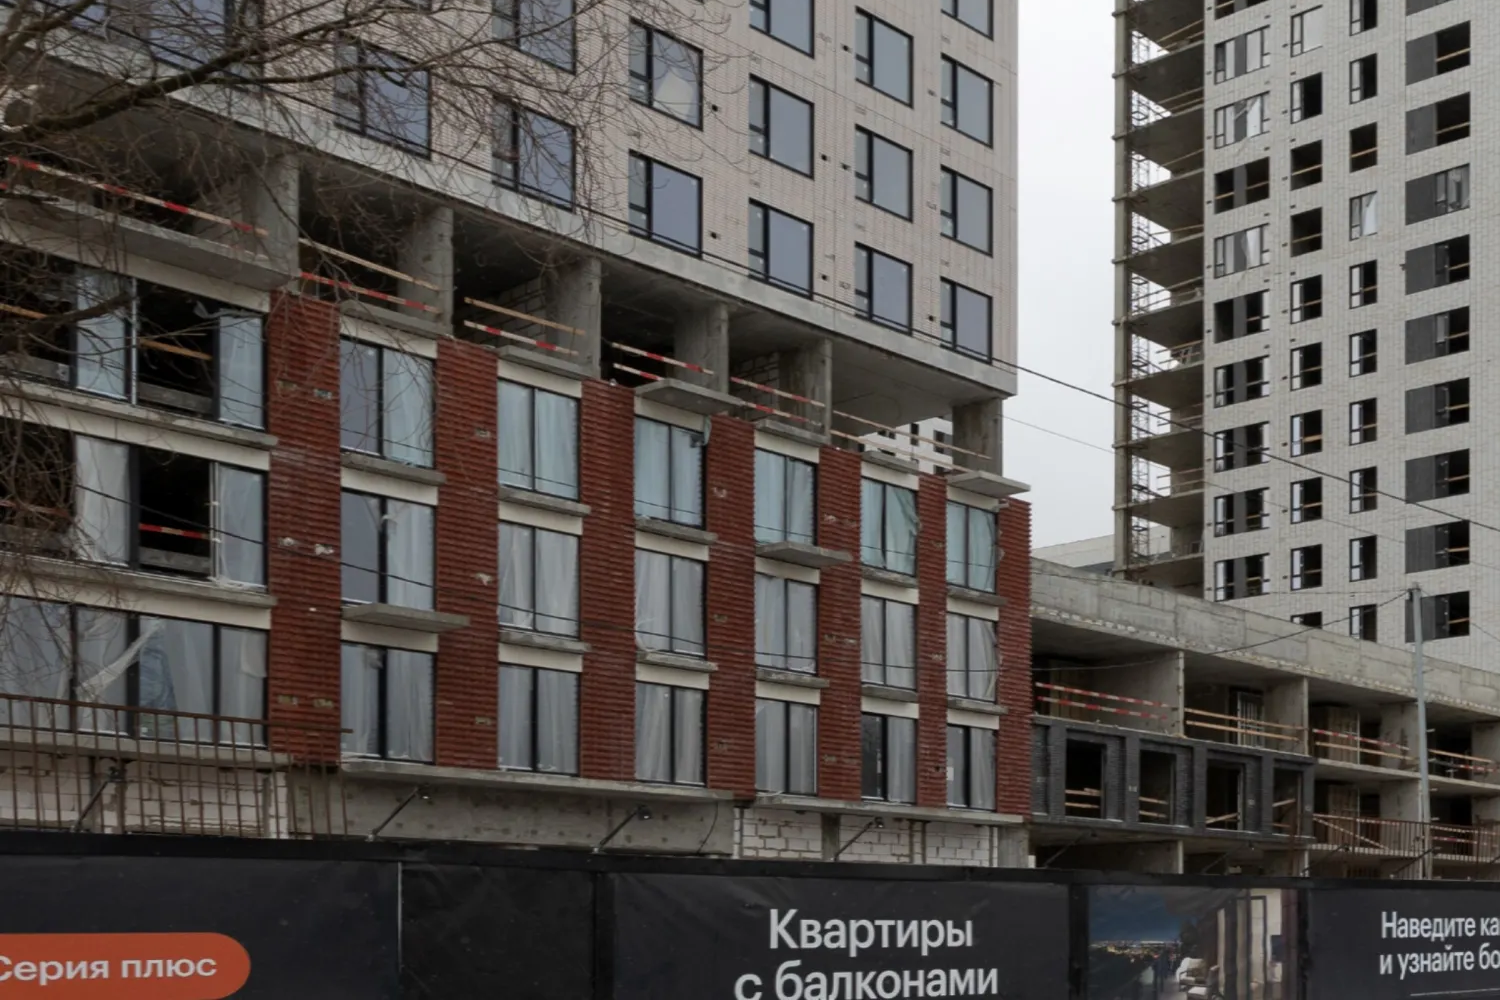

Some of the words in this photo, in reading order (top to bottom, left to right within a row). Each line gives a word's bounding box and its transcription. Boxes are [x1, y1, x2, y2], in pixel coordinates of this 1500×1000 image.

[769, 908, 973, 957] Квартиры
[1381, 911, 1476, 942] Наведите
[121, 958, 217, 979] плюс
[734, 973, 763, 1000] с
[775, 960, 998, 1000] балконами
[1379, 954, 1393, 975] и
[1397, 944, 1475, 980] узнайте
